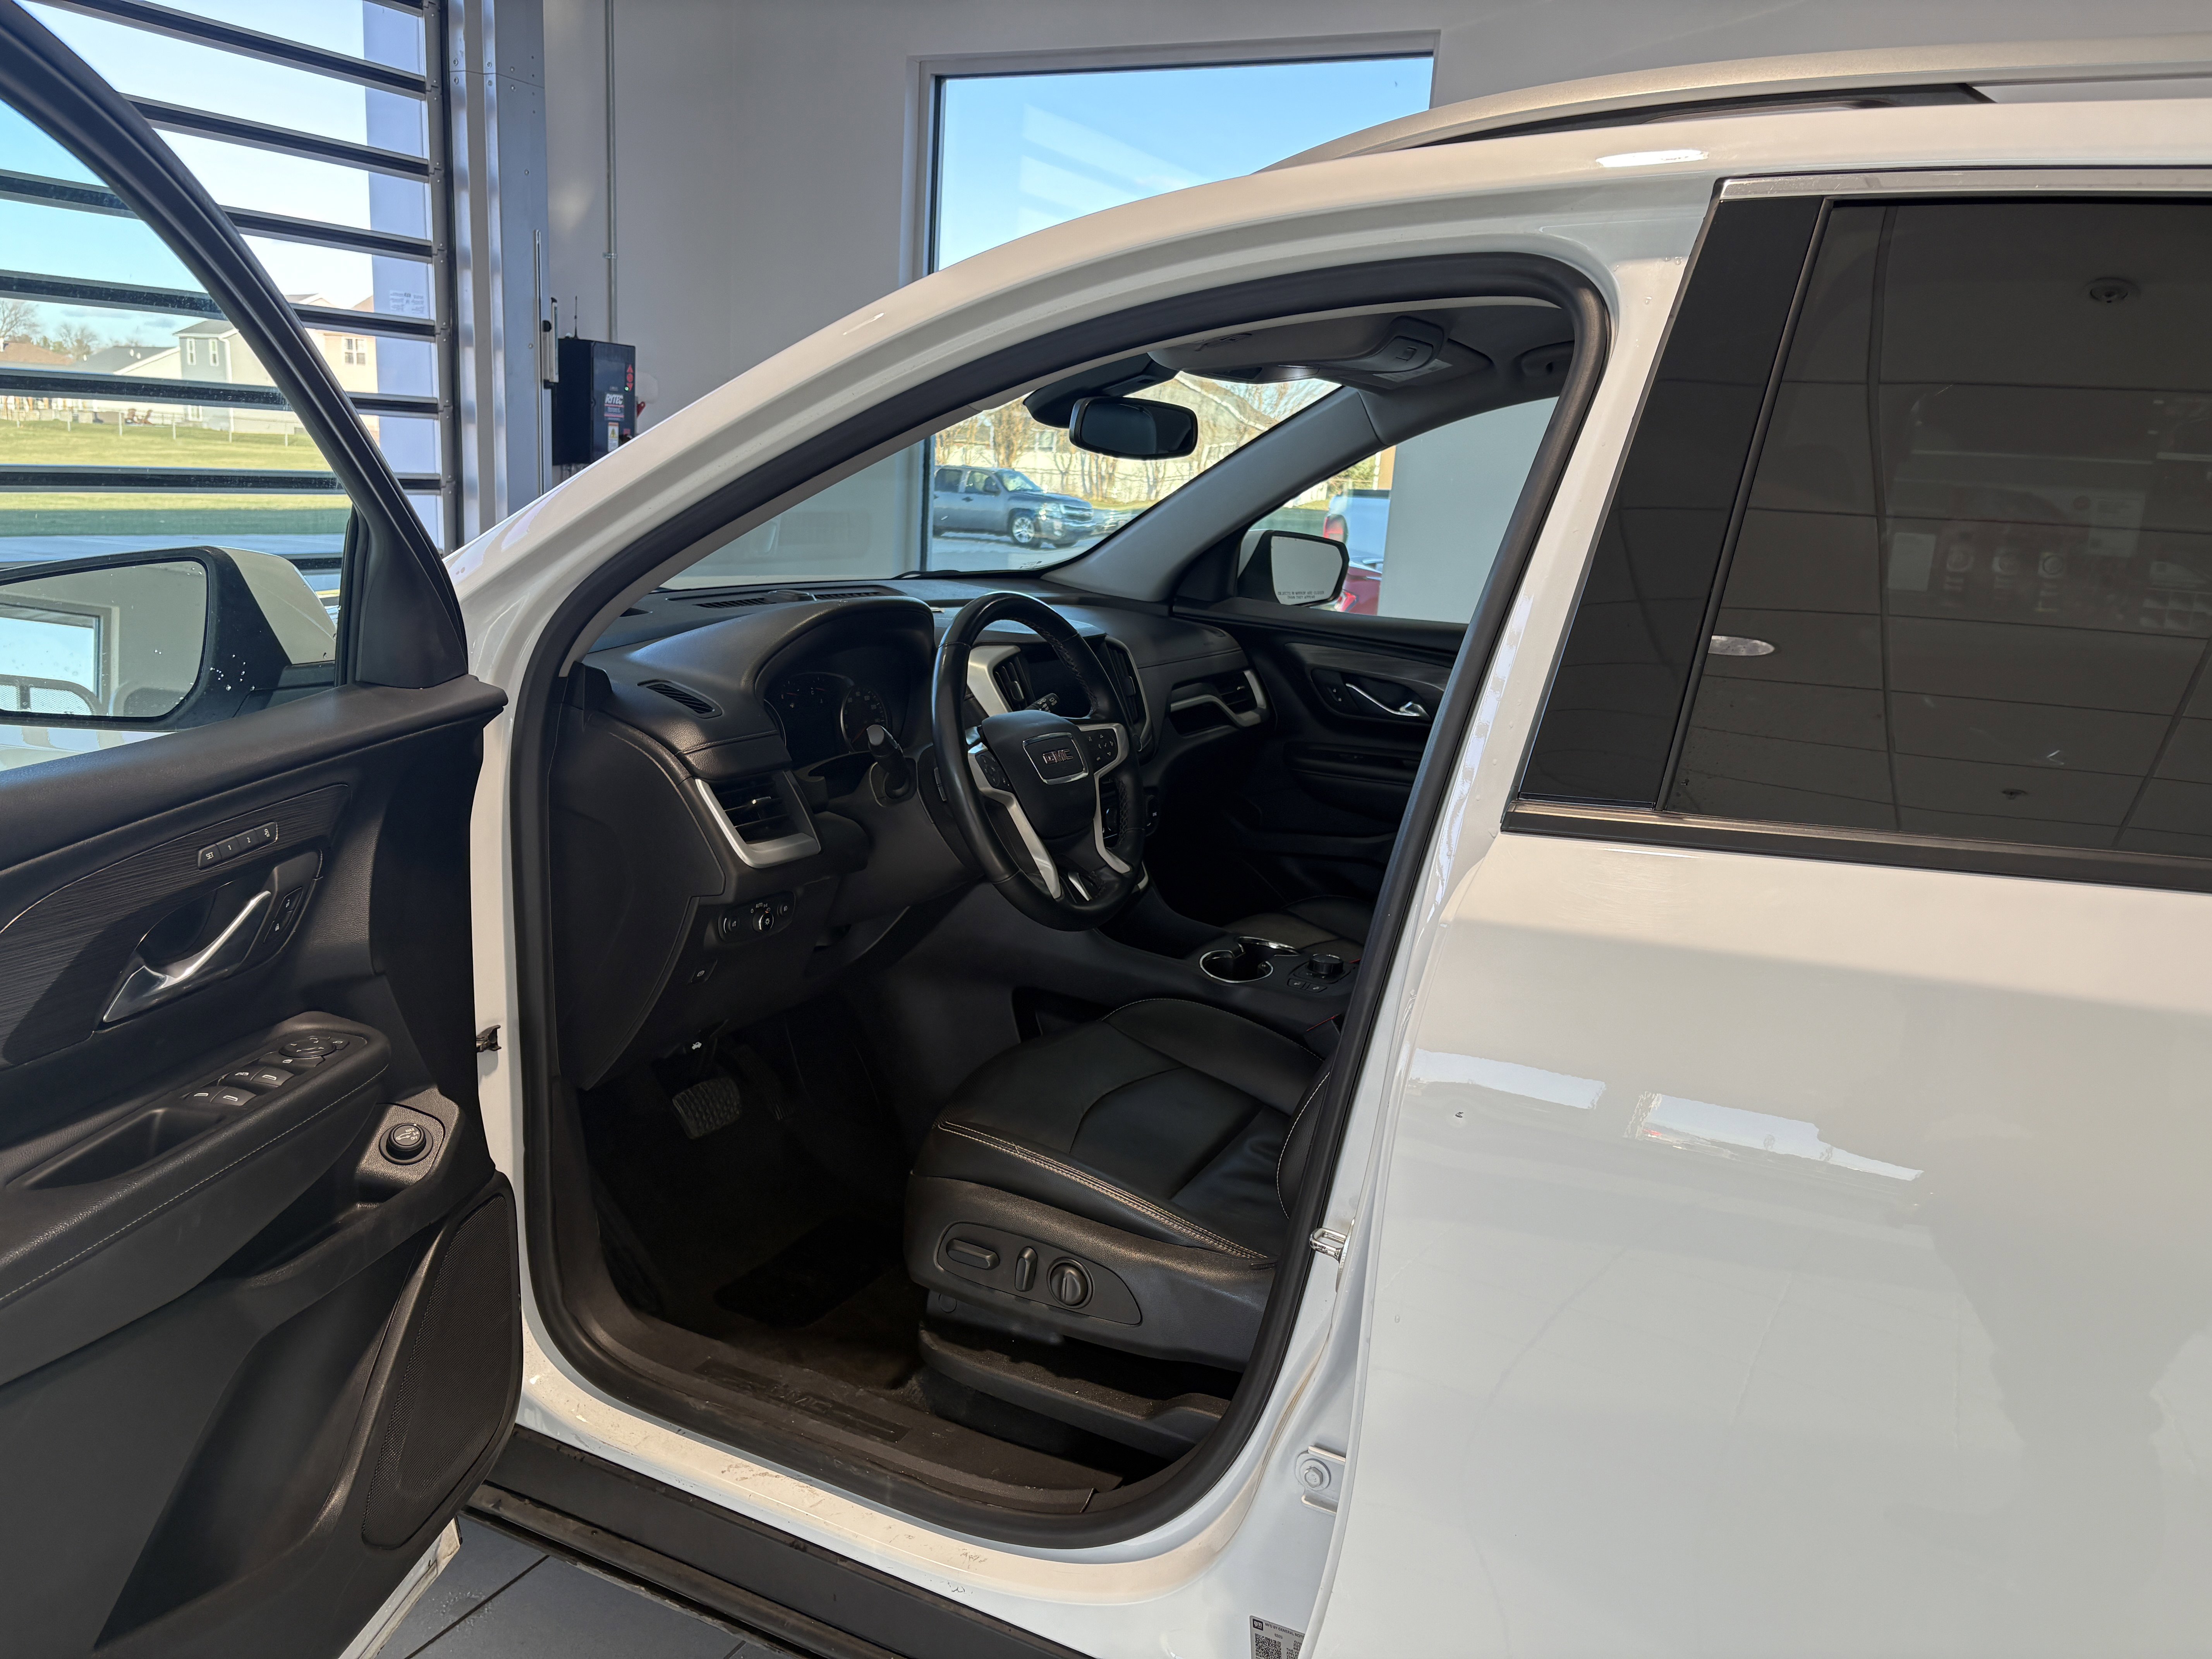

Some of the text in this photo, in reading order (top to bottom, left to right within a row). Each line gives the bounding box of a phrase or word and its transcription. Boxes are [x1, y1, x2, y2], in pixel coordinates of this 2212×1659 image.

[605, 393, 623, 404] RYTEC
[1042, 749, 1073, 764] GMC
[1254, 1621, 1262, 1629] gm
[1278, 1627, 1294, 1636] GENERAL
